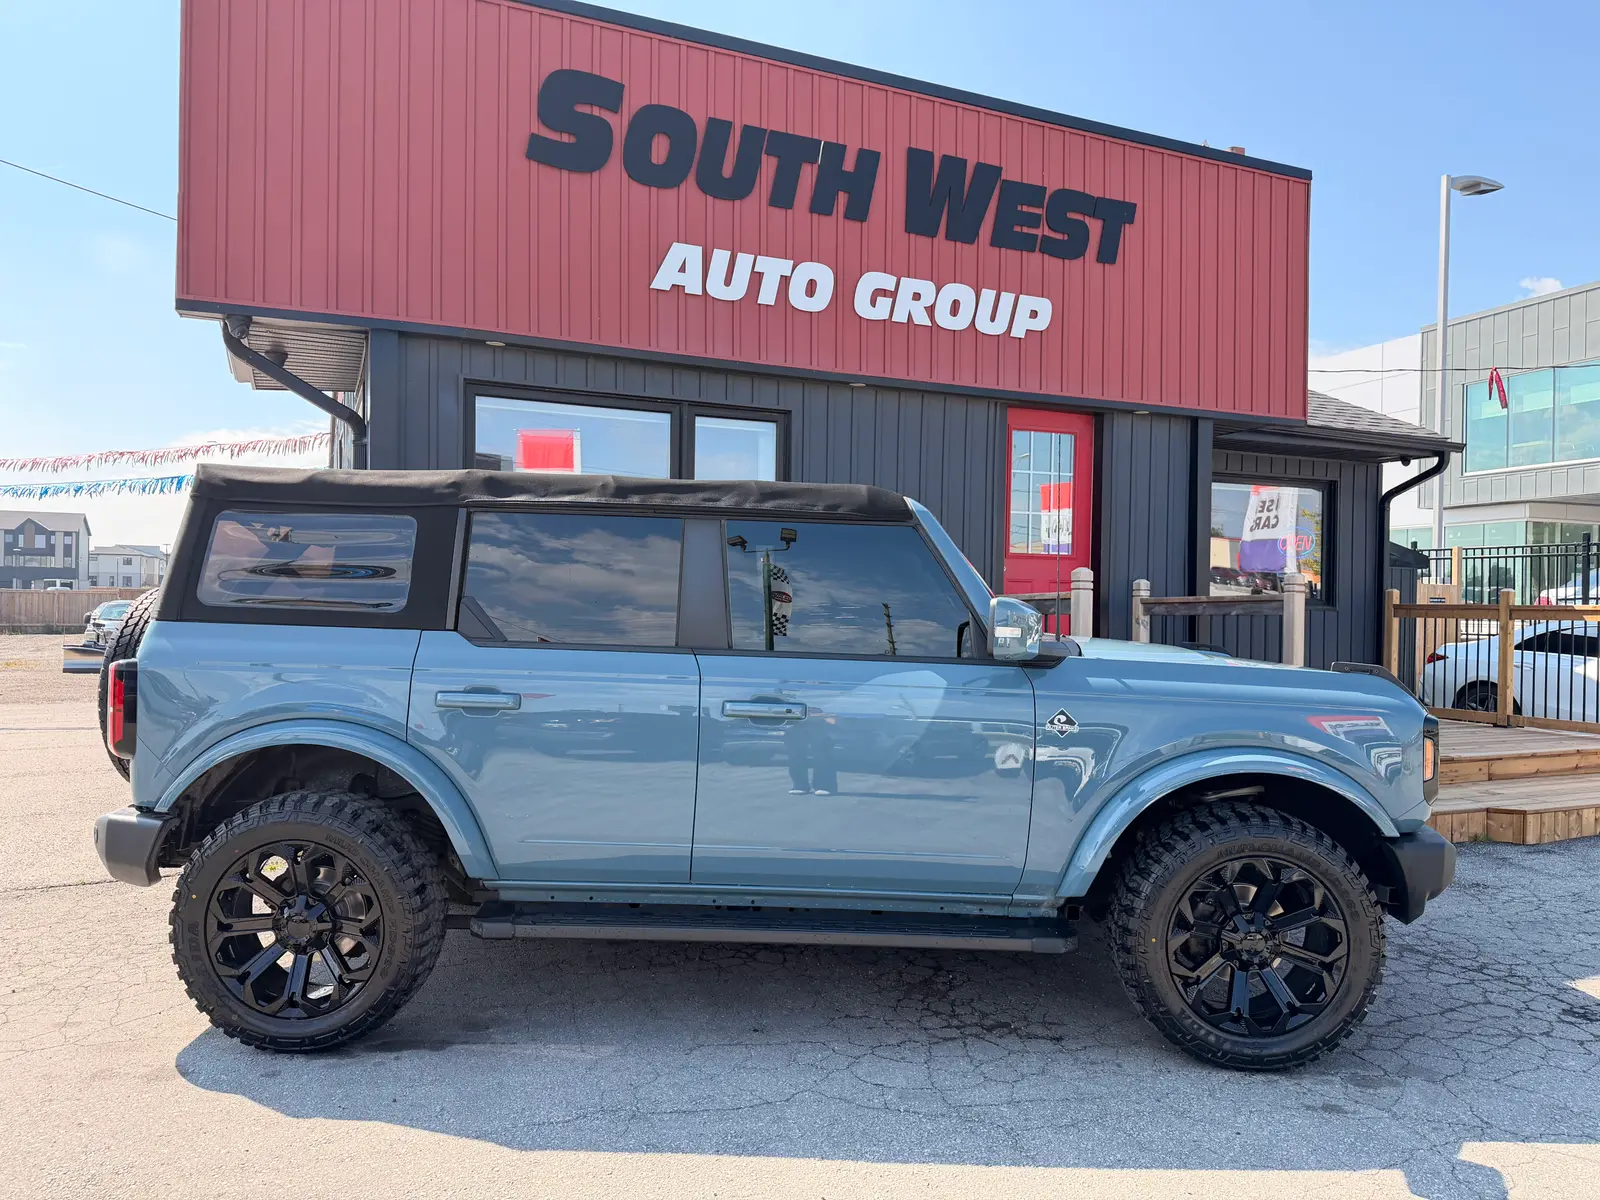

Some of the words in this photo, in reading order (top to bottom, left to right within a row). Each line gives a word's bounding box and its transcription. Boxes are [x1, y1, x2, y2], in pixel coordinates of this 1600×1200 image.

[526, 69, 881, 222] SOUTH
[905, 147, 1137, 264] WEST
[650, 242, 834, 312] AUTO
[854, 272, 1052, 338] GROUP
[1280, 536, 1312, 550] OPEN
